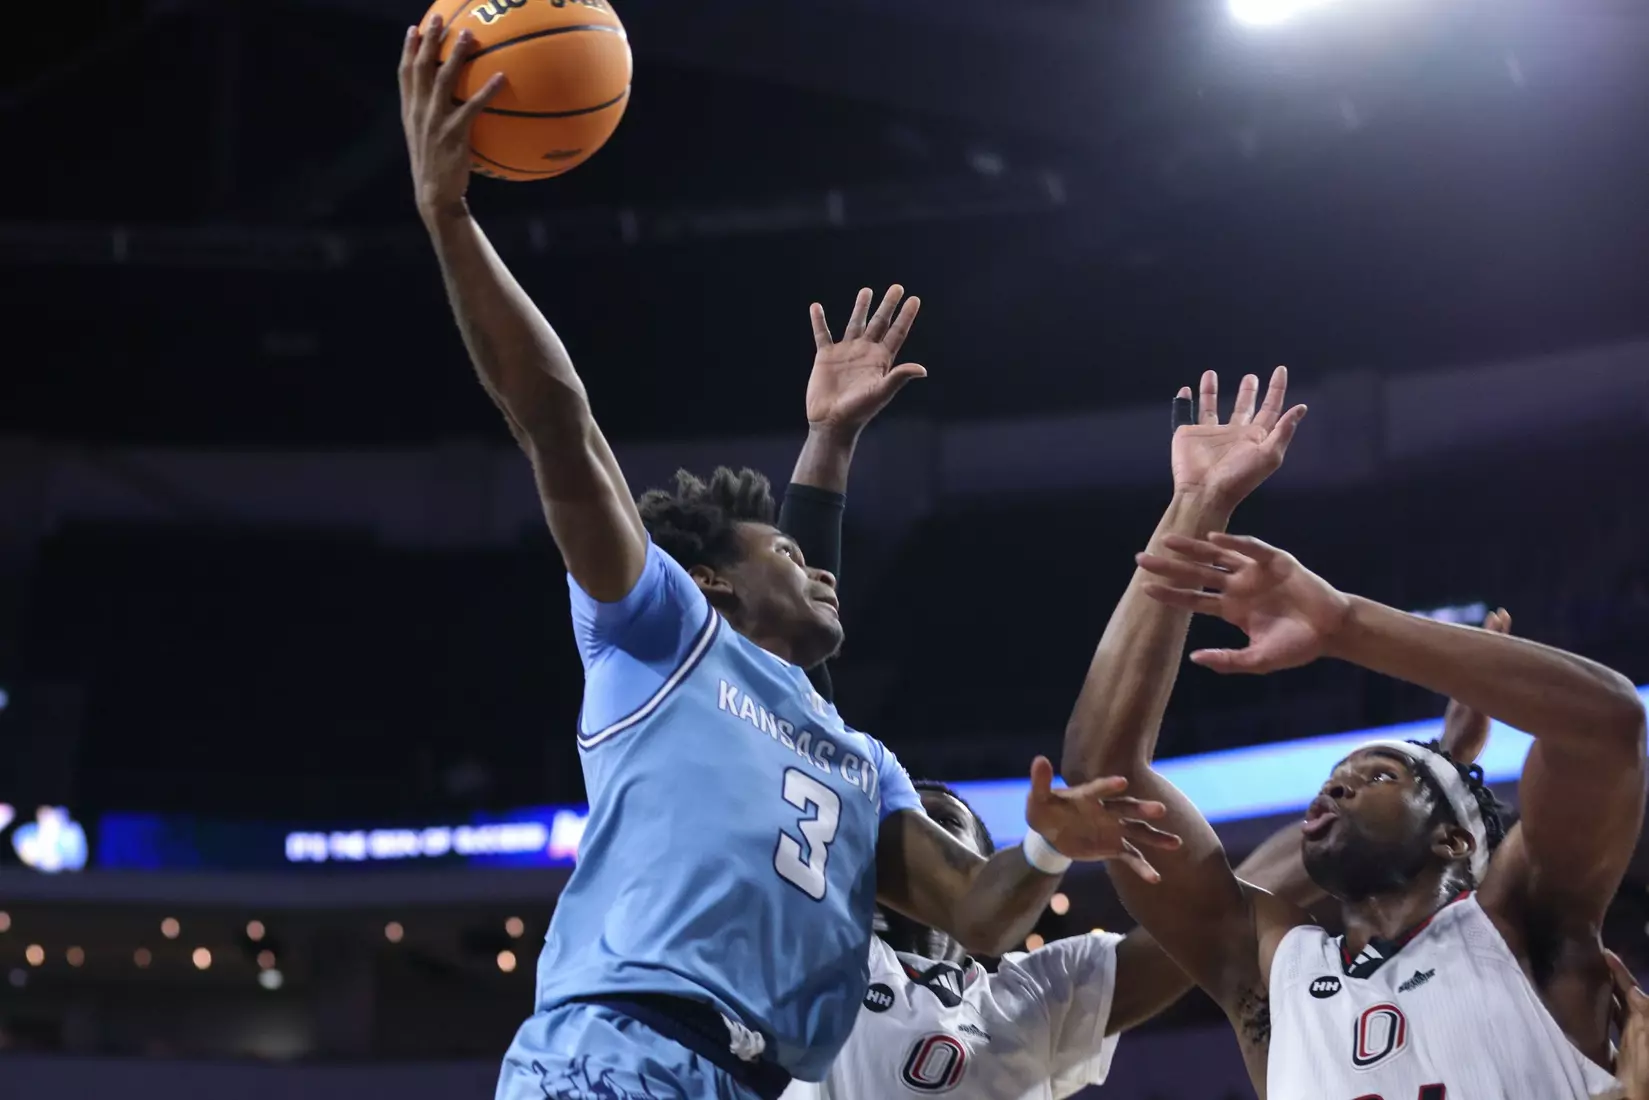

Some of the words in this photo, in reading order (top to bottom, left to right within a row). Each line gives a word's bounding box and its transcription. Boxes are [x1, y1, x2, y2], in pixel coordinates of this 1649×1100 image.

[717, 678, 836, 775] KANSAS
[839, 752, 881, 815] CIT
[772, 765, 843, 903] 3
[866, 988, 892, 1007] HH
[1312, 981, 1339, 991] HH
